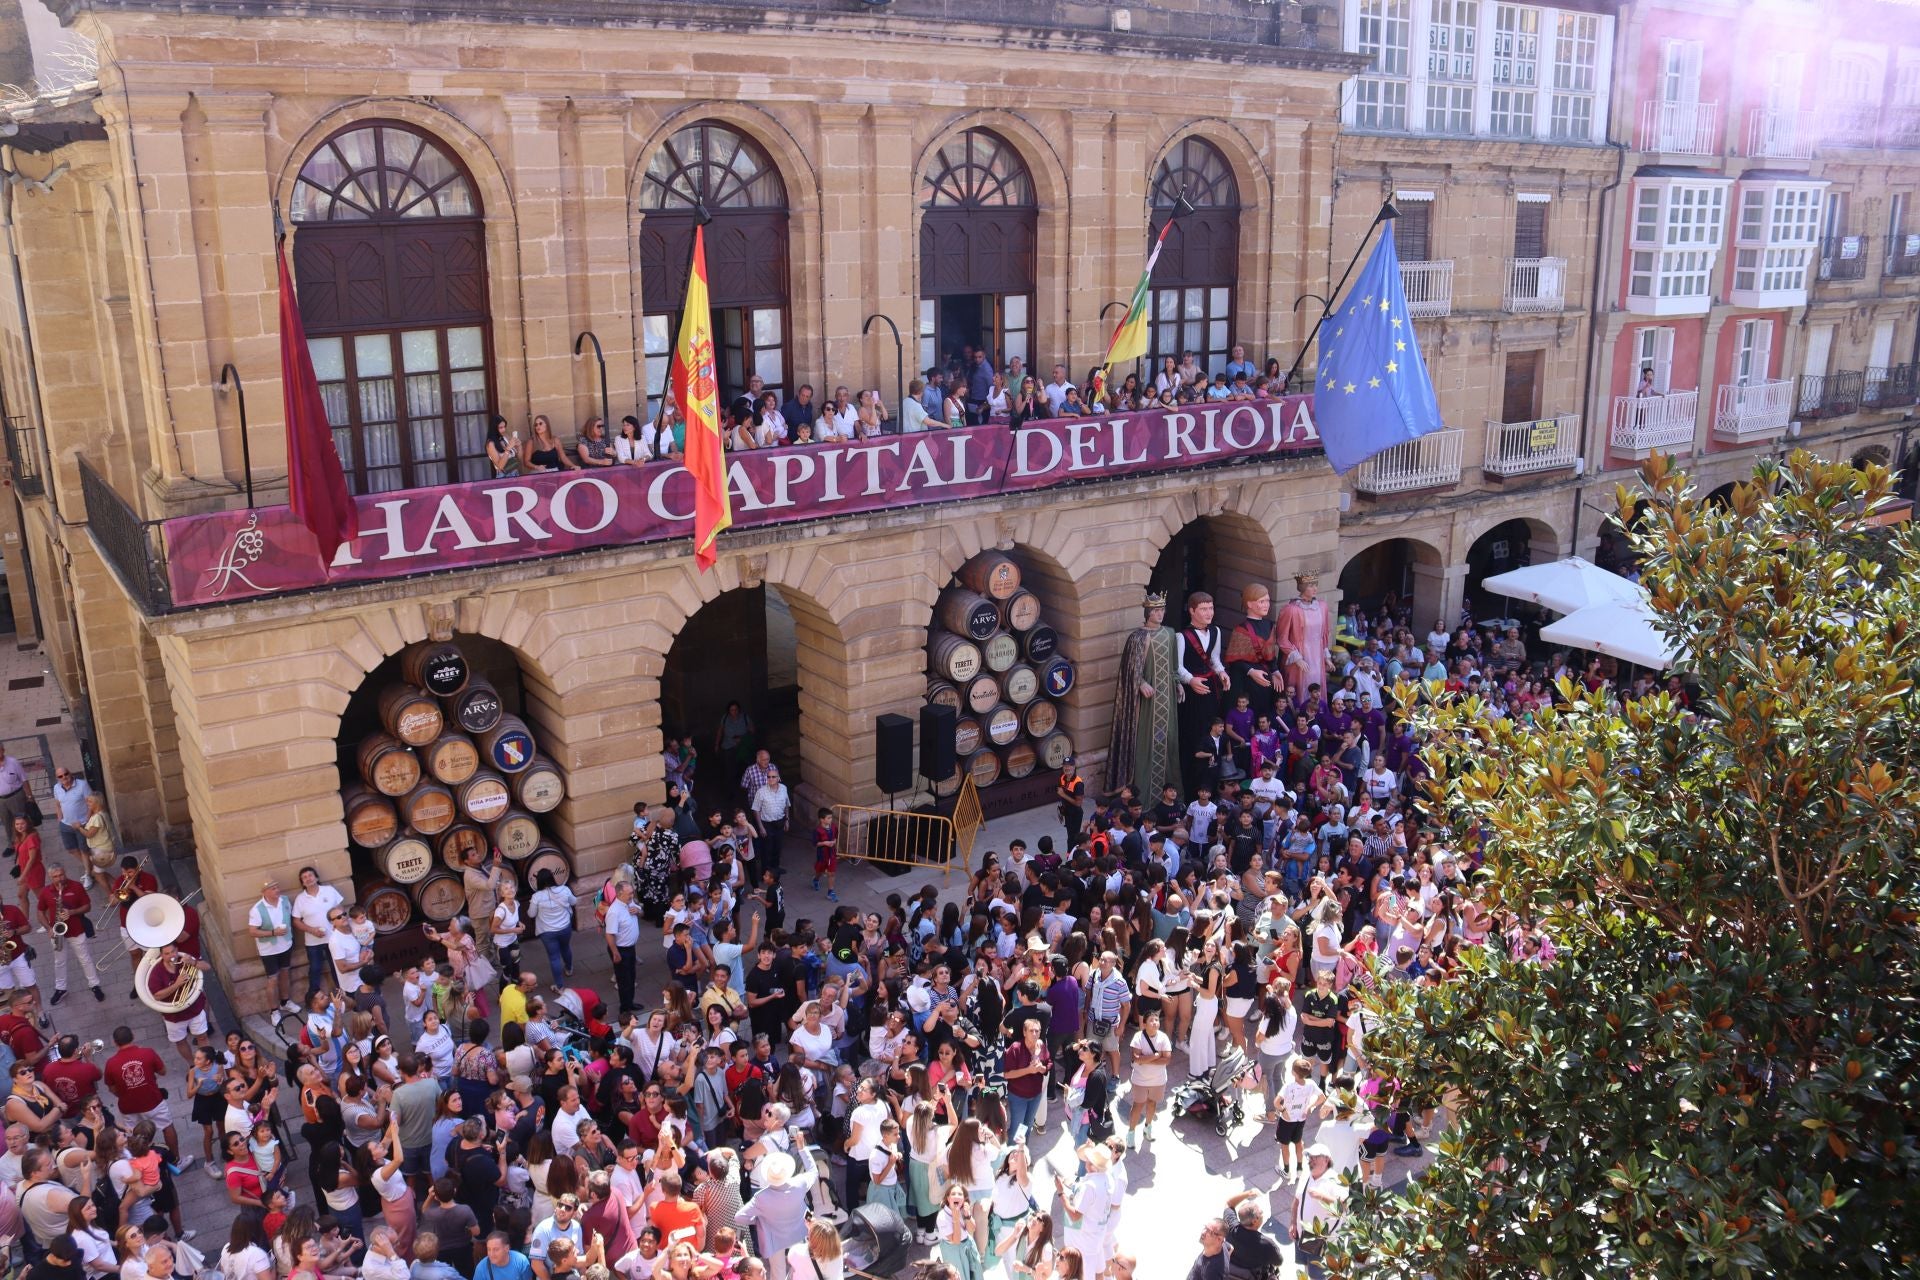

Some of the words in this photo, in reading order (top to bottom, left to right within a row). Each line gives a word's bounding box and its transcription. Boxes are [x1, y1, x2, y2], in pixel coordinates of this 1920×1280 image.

[1429, 30, 1446, 45] SE
[1466, 33, 1536, 55] VENDE
[1428, 57, 1533, 80] EDIFICIO
[330, 477, 619, 568] HARO
[647, 433, 993, 521] CAPITAL
[1010, 418, 1147, 478] DEL
[1162, 400, 1321, 459] RIOJA
[508, 842, 531, 851] RODA
[397, 857, 423, 870] TERETE
